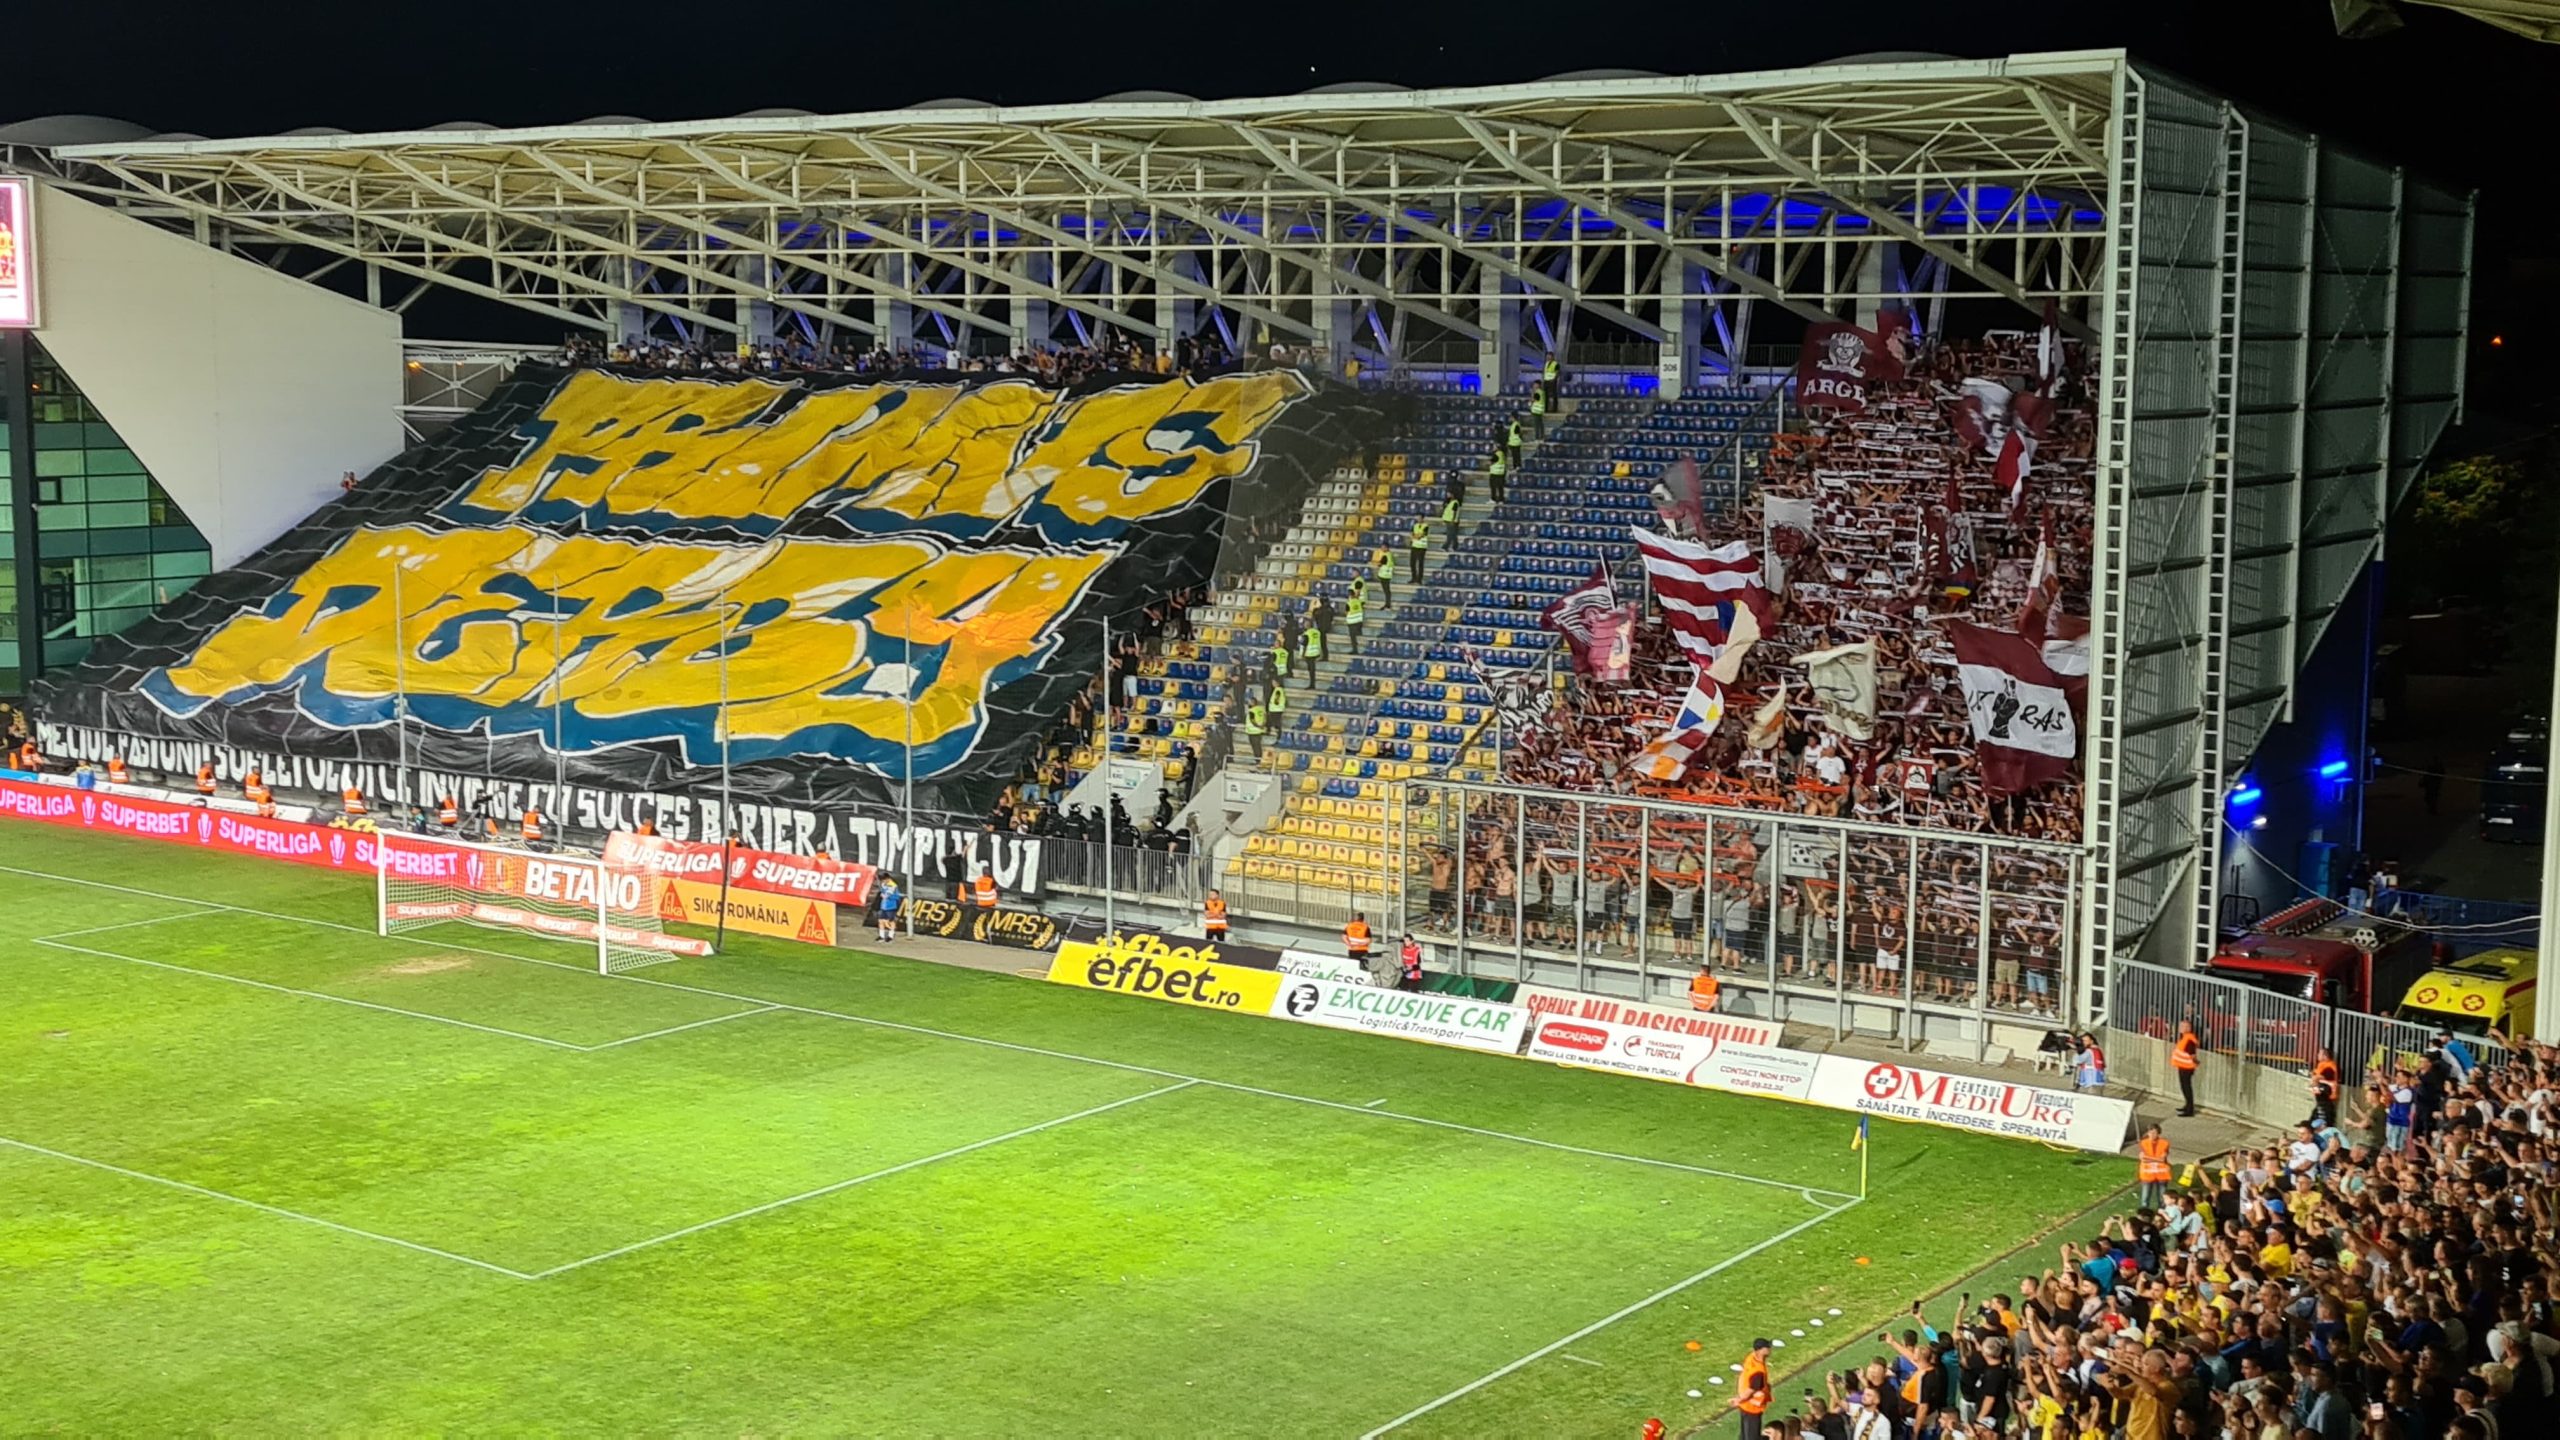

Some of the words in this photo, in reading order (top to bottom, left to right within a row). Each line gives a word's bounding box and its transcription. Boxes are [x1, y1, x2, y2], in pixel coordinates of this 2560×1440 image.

[101, 802, 191, 834] SUPERBET
[219, 816, 322, 855] SUPERLIGA
[355, 839, 458, 876] SUPERBET
[617, 841, 723, 873] SUPERLIGA
[752, 859, 861, 893] SUPERBET
[525, 860, 641, 911] BETANO
[693, 897, 724, 914] SIKA
[989, 910, 1039, 935] MRS
[1328, 987, 1453, 1024] EXCLUSIVE
[1460, 1007, 1512, 1032] CAR
[1645, 1047, 1682, 1061] TURCIA
[1719, 1065, 1759, 1078] CONTACT
[1953, 1081, 2002, 1099] CENTRUL
